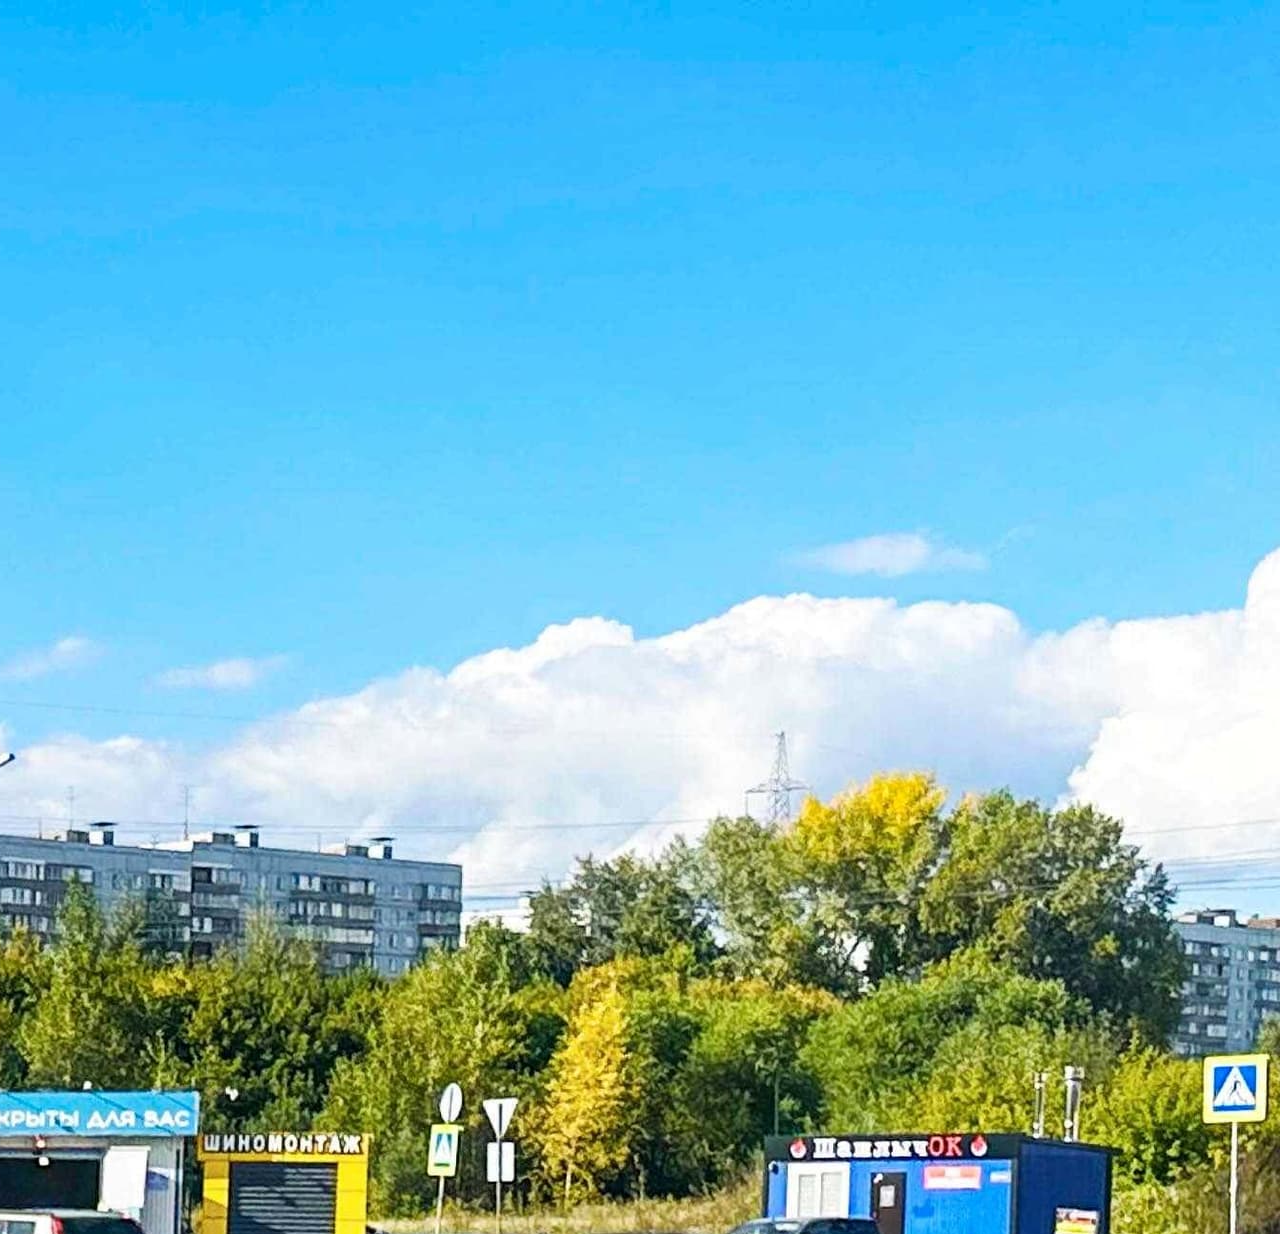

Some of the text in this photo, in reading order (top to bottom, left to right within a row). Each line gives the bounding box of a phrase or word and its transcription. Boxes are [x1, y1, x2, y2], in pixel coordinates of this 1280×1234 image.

[86, 1110, 137, 1130] ДЛЯ
[143, 1110, 190, 1129] ВАС
[203, 1133, 363, 1156] ШИНОМОНТАЖ
